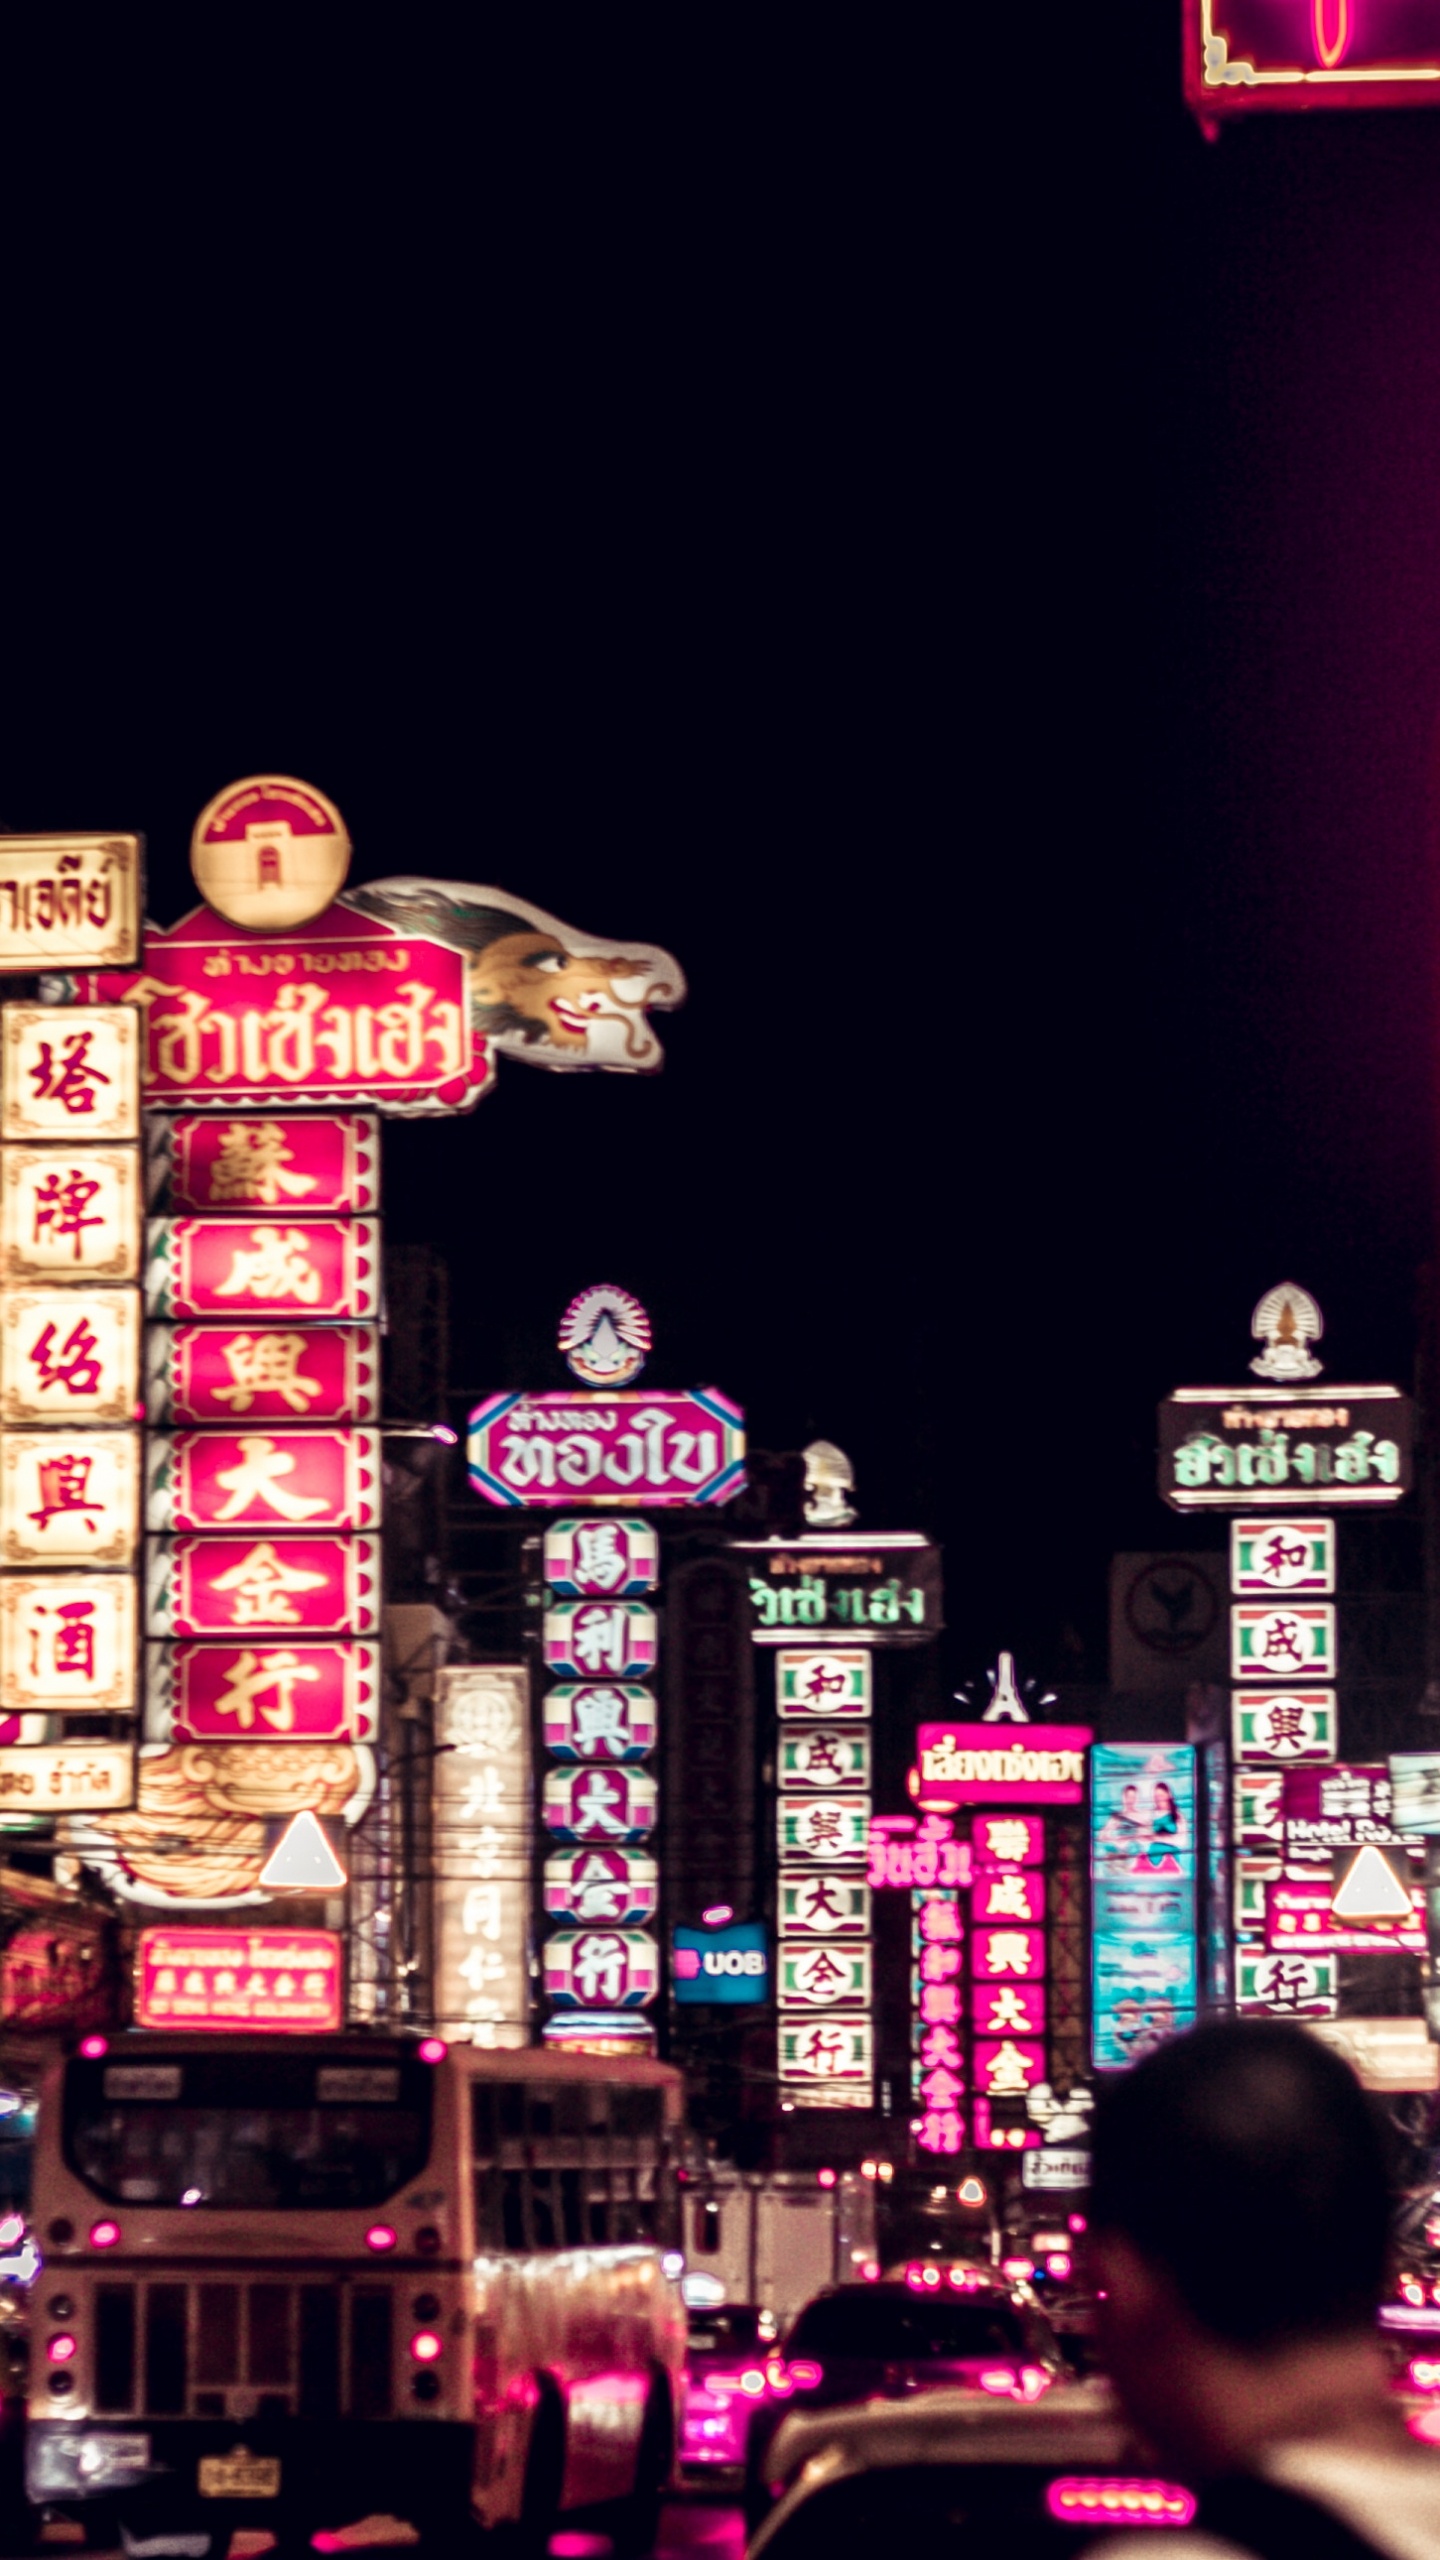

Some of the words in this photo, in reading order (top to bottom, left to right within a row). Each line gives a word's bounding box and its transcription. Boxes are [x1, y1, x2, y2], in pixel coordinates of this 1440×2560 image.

[1261, 1535, 1308, 2001] 和成興行
[703, 1951, 767, 1977] UOB
